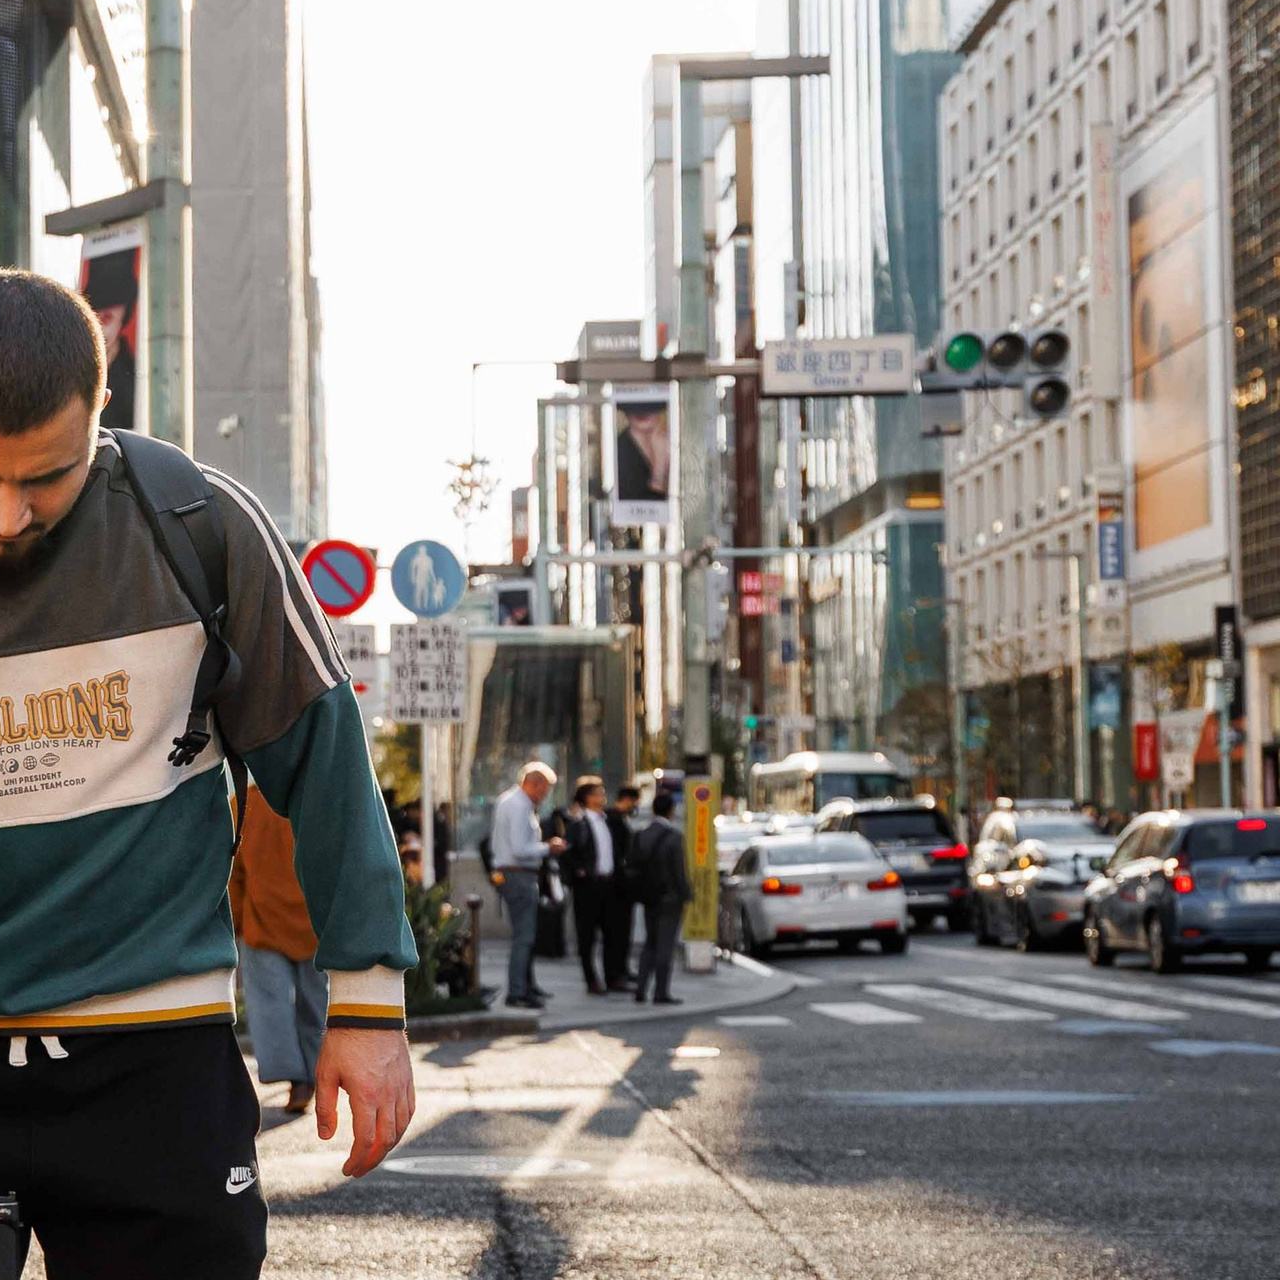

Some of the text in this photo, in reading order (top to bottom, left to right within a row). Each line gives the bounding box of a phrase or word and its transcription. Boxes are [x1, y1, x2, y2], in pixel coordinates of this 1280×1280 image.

[776, 349, 903, 373] 銀座四丁目
[0, 744, 21, 756] FOR
[24, 740, 59, 751] LION'S
[63, 737, 101, 749] HEART
[4, 771, 62, 786] UNI PRESIDENT
[40, 782, 62, 791] TEAM
[64, 777, 86, 787] CORP
[230, 1166, 254, 1183] NIKE
